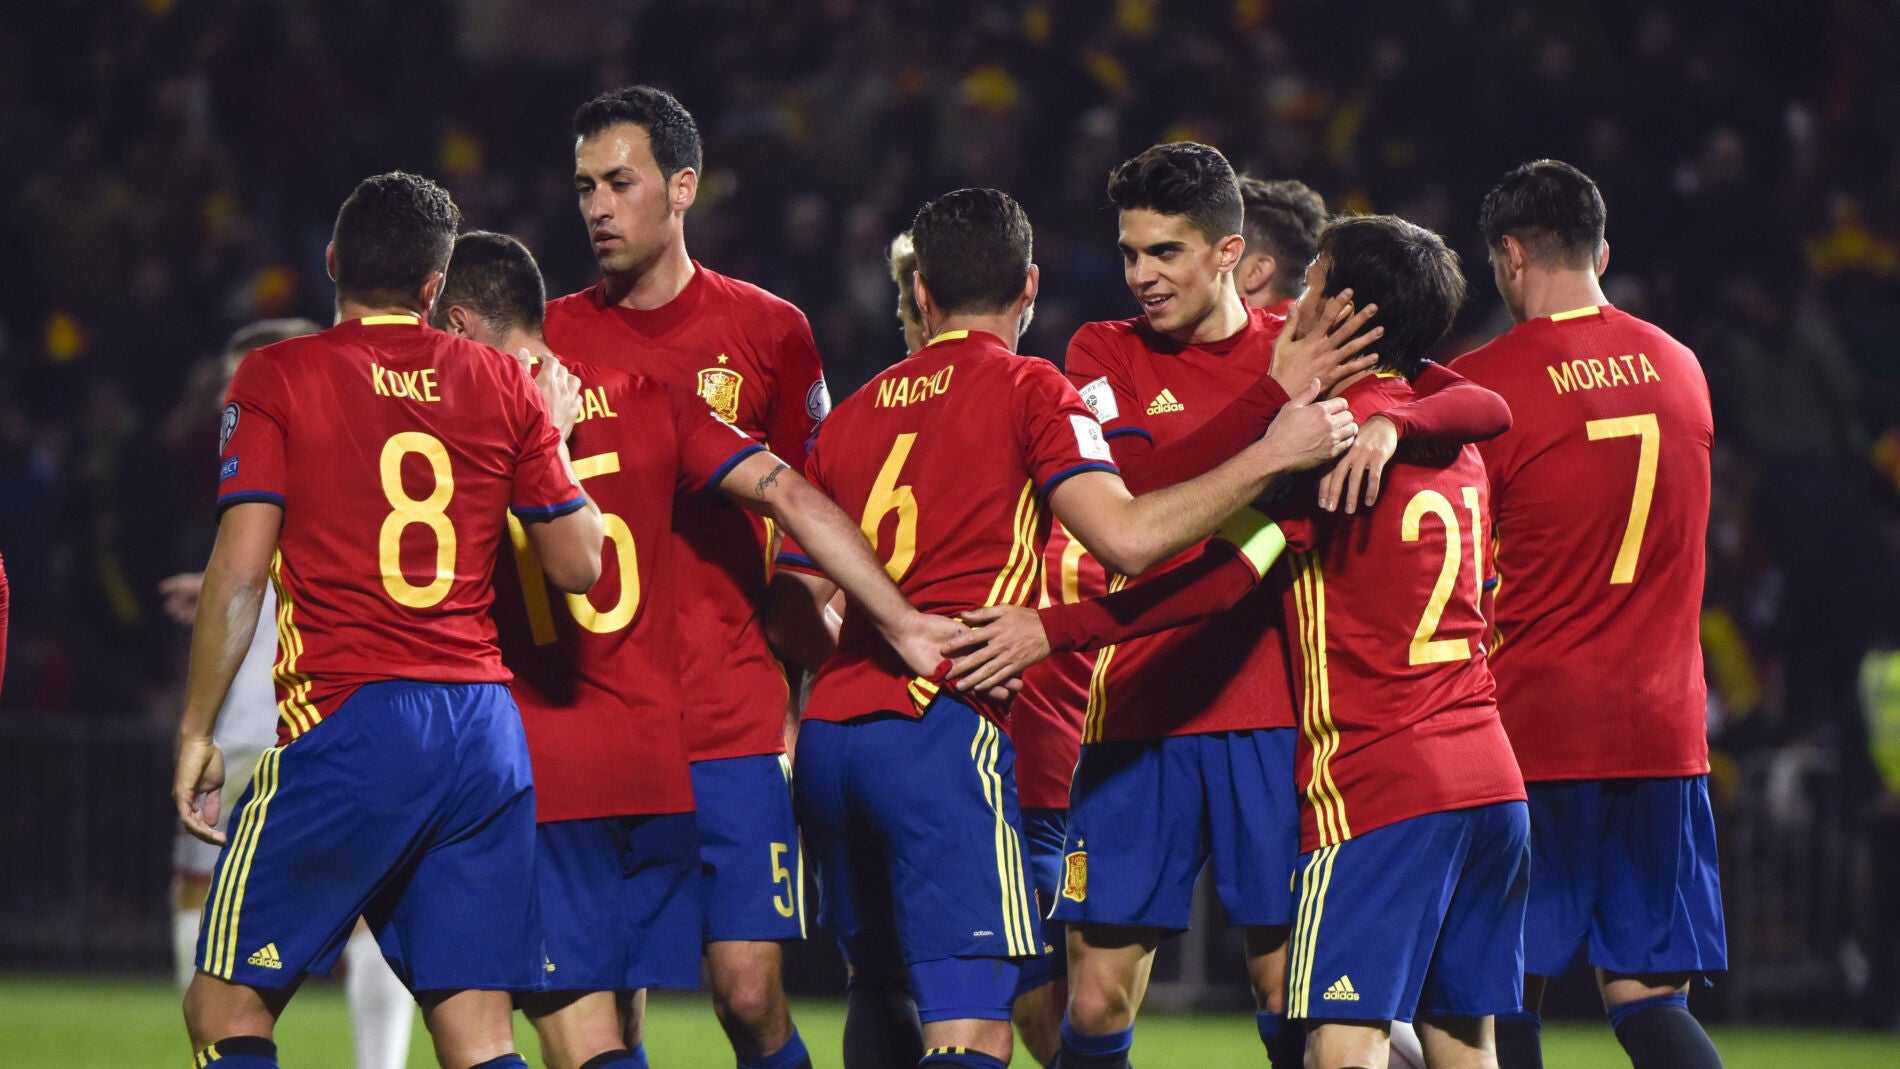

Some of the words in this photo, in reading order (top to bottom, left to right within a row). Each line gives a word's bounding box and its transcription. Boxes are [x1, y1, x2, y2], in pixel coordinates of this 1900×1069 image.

[371, 362, 441, 402] KOKE
[874, 365, 954, 409] NACHO
[1546, 352, 1661, 395] MORATA
[1146, 402, 1185, 416] adidas
[379, 431, 457, 608] 8
[860, 432, 919, 583] 6
[1585, 413, 1660, 585] 7
[1401, 486, 1487, 666] 21
[770, 842, 795, 917] 5
[247, 956, 283, 970] adidas
[1323, 989, 1360, 1001] adidas
